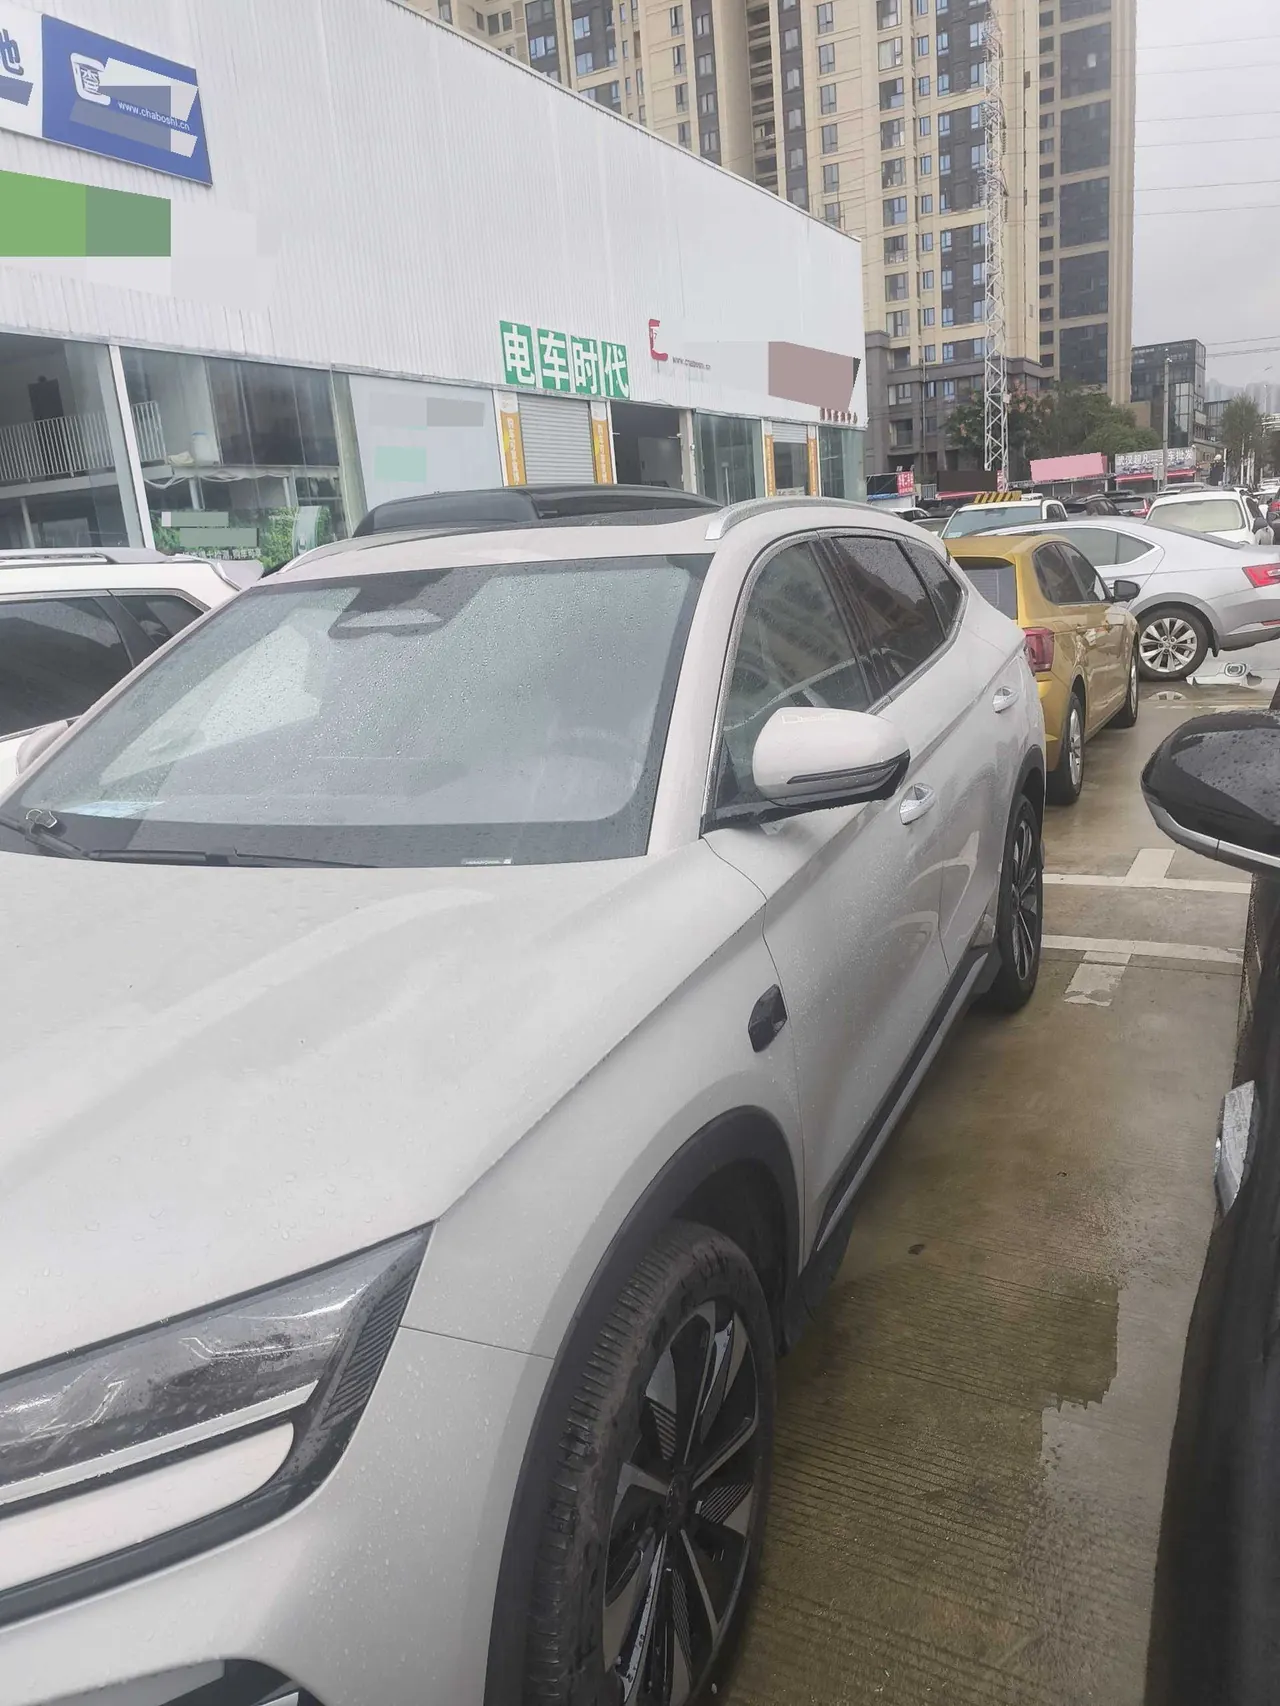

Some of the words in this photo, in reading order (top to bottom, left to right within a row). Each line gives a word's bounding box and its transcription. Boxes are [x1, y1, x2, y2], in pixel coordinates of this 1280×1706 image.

[117, 100, 191, 131] www.chaboshi.cn
[503, 324, 630, 398] 电车时代
